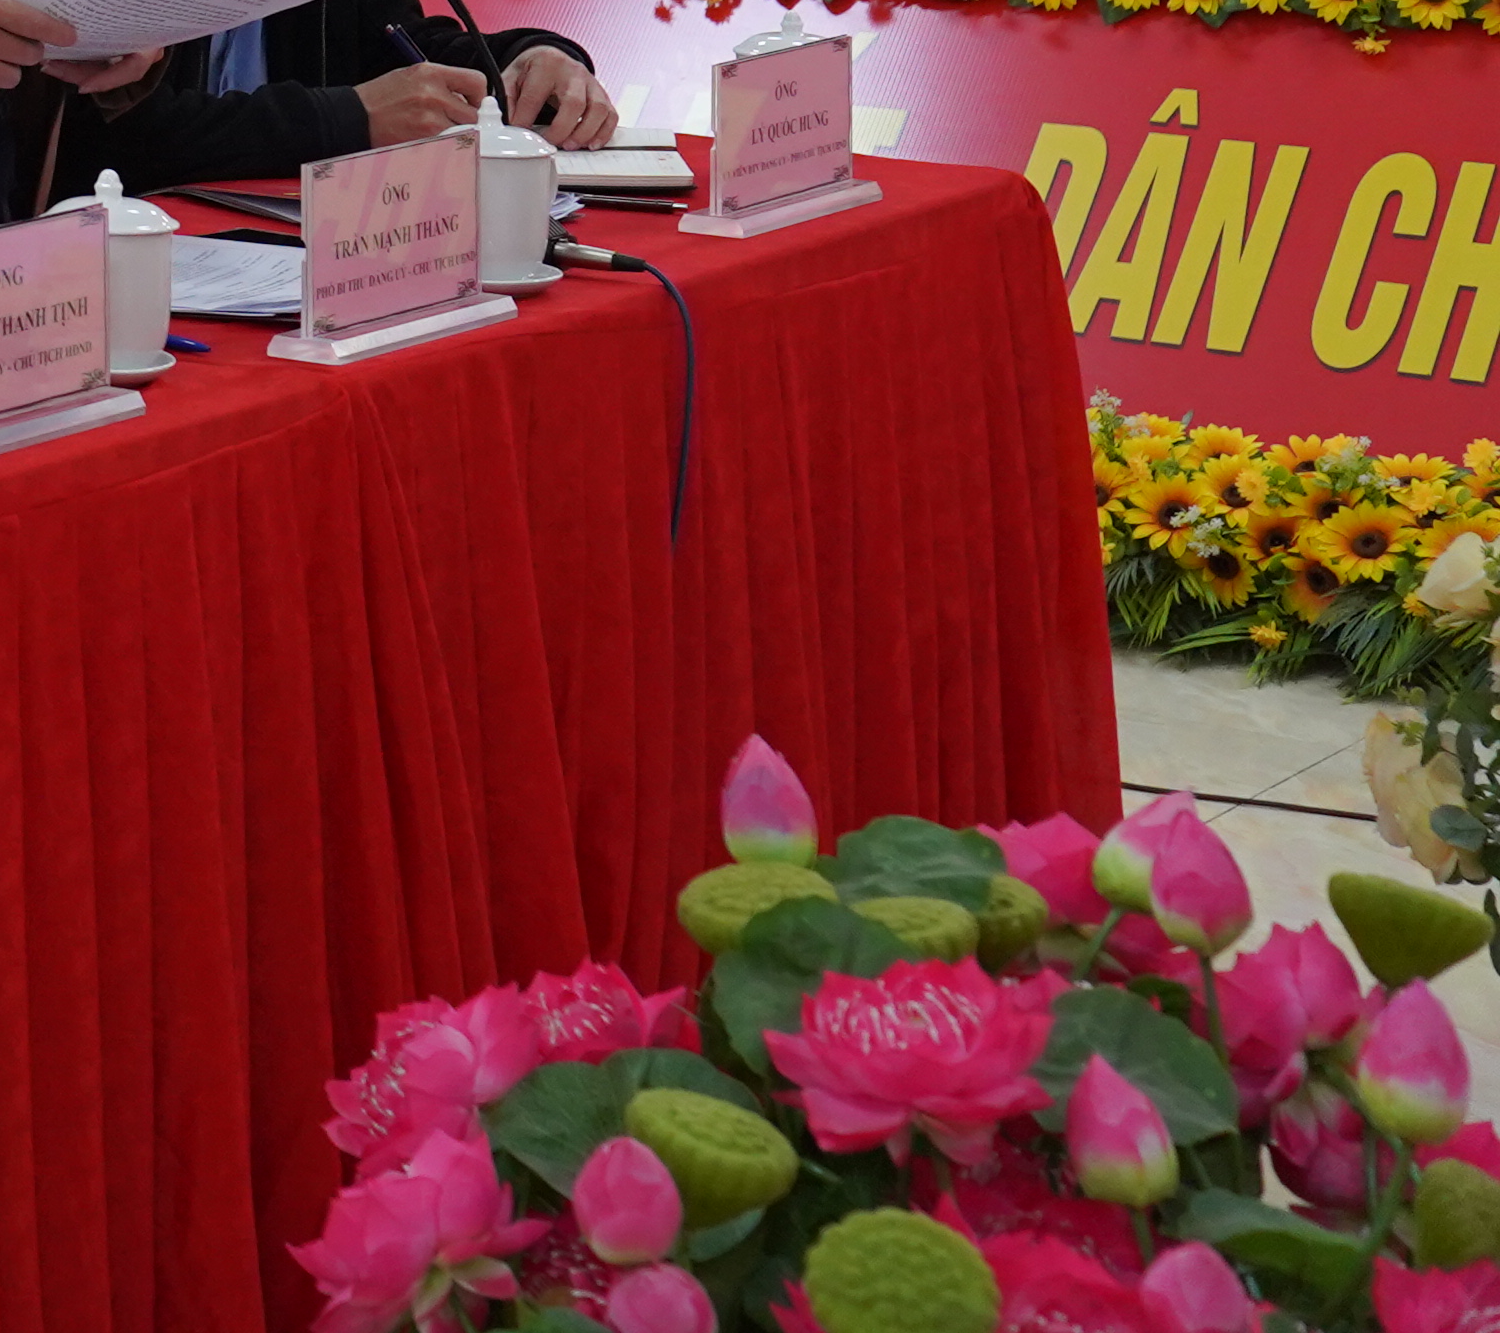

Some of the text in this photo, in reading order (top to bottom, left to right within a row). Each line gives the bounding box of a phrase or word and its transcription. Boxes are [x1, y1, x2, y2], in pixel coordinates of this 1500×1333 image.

[775, 80, 798, 101] ÔNG
[382, 182, 411, 206] ÔNG
[1023, 88, 1311, 354] DÂN
[334, 232, 370, 261] TRẦN
[372, 224, 412, 254] MẠNH
[51, 296, 89, 328] TỊNH
